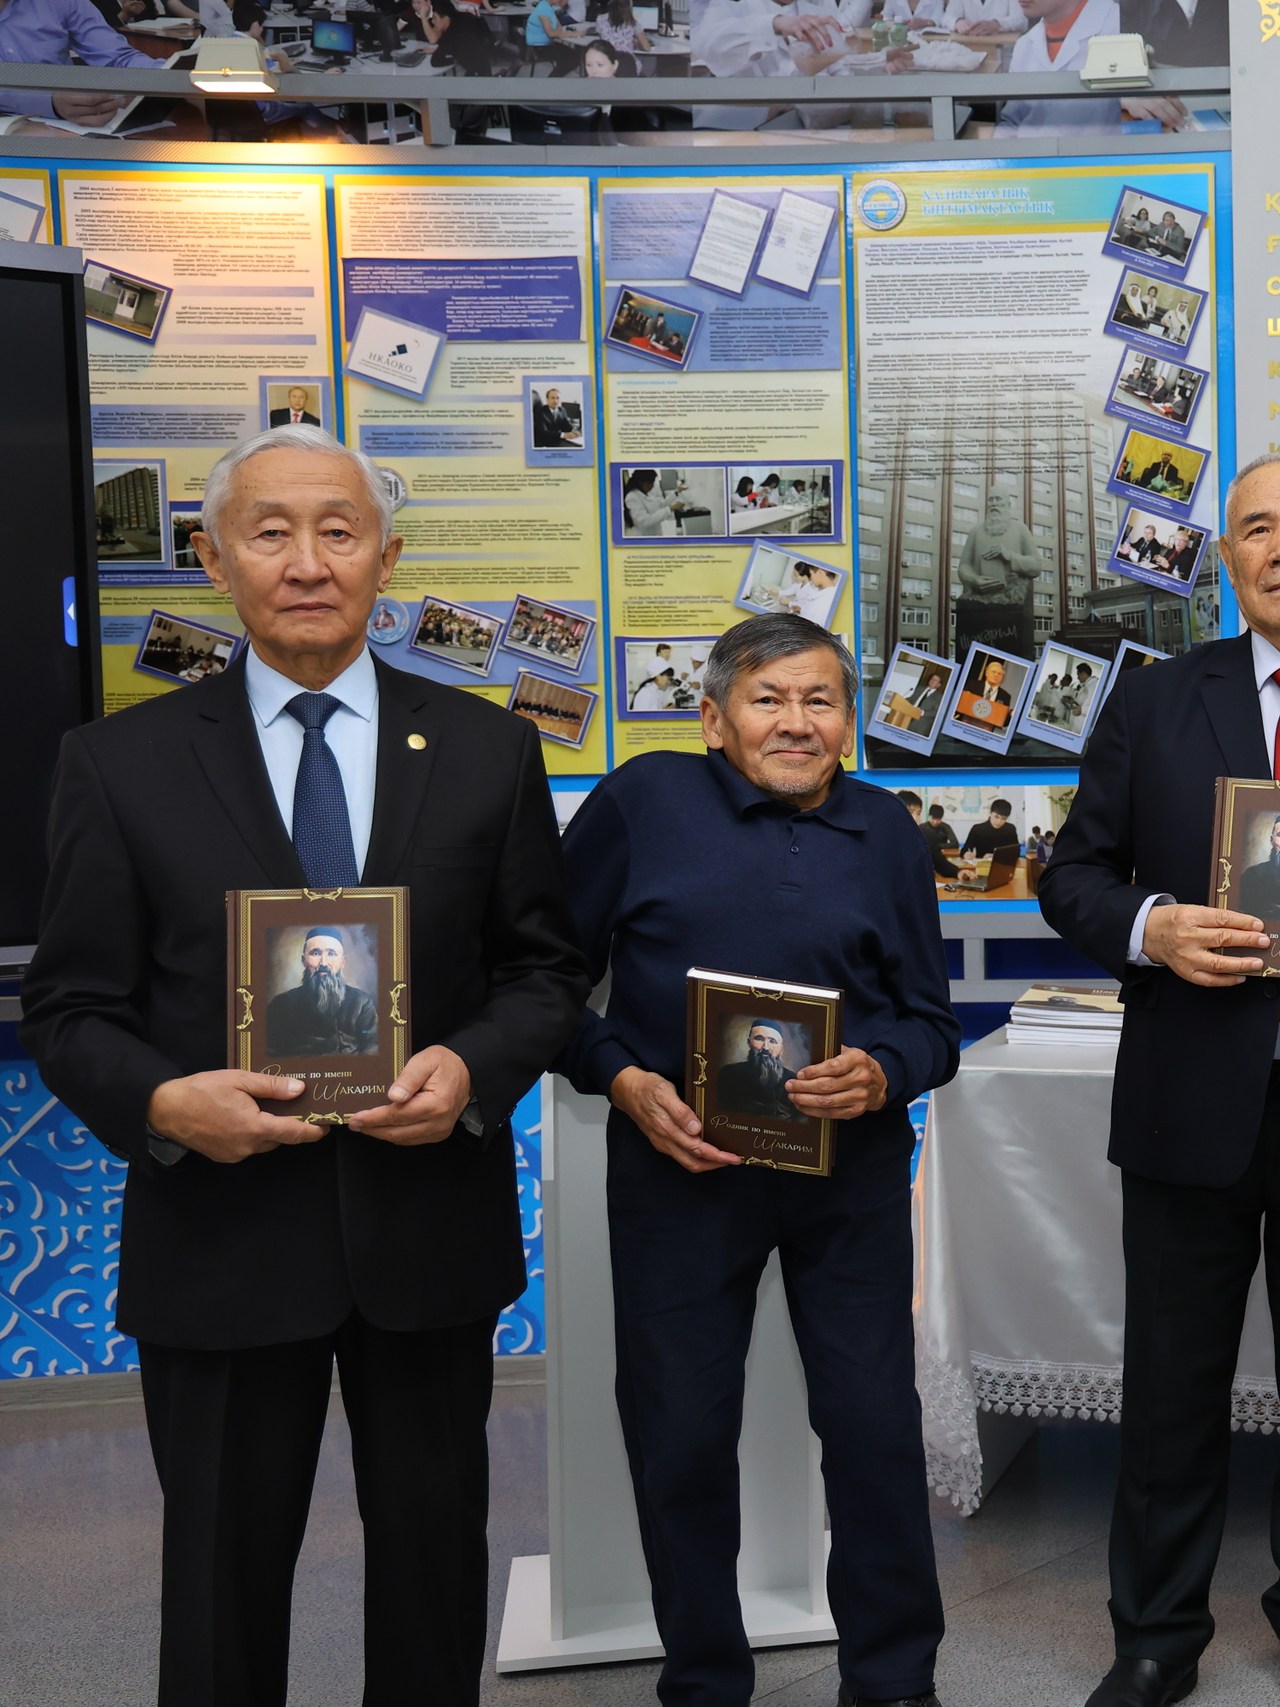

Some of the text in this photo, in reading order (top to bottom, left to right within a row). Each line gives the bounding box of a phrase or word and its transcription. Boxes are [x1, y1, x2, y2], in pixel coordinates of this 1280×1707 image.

[313, 1082, 386, 1102] ШАКАРИМ
[710, 1115, 748, 1130] Родник
[753, 1136, 813, 1153] ШАКАРИМ
